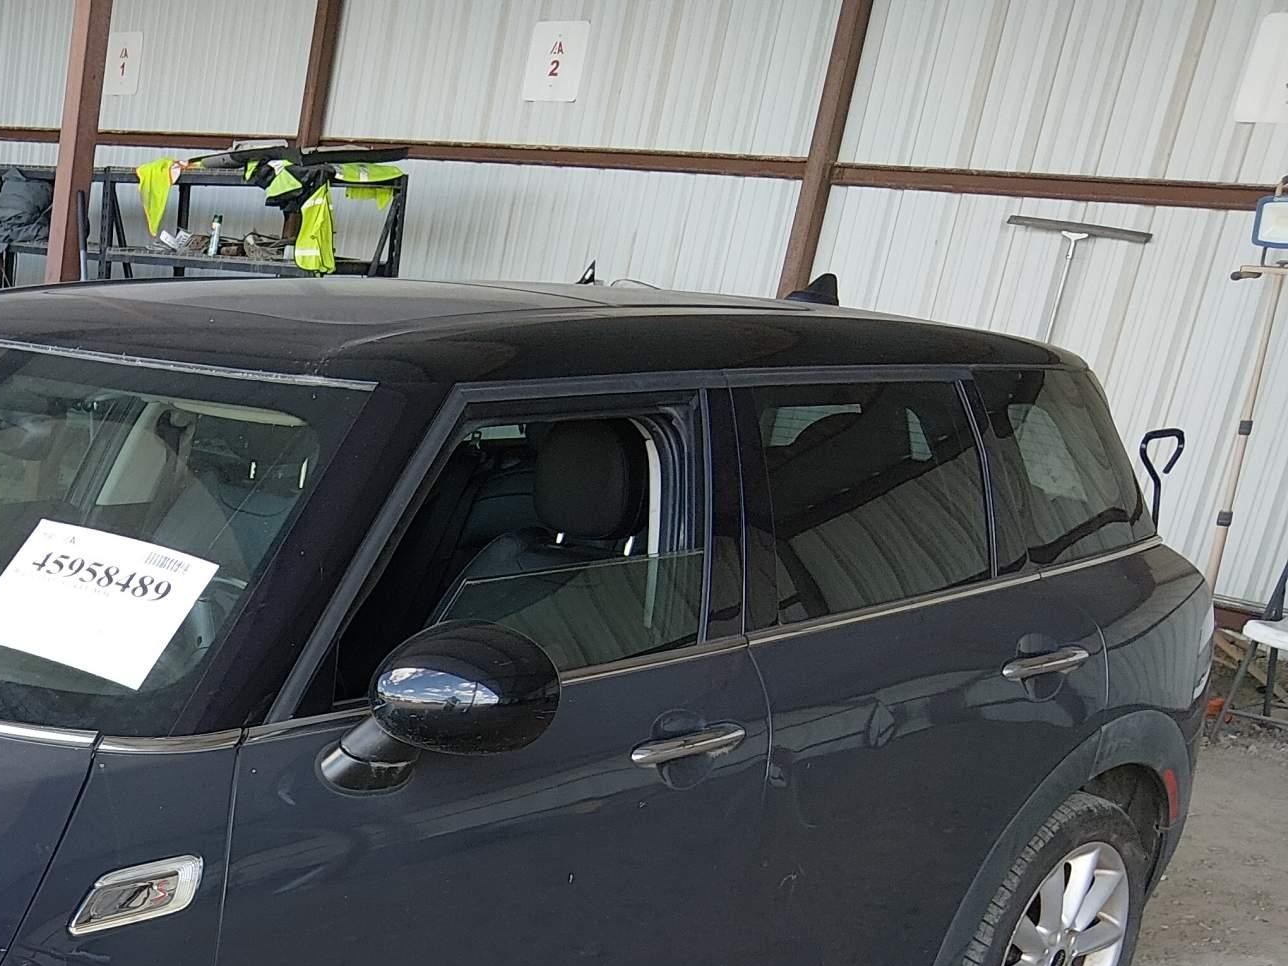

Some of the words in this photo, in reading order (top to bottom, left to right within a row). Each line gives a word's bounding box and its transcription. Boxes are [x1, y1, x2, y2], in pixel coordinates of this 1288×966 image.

[120, 61, 126, 77] 1
[548, 59, 560, 77] 2
[32, 551, 172, 601] 45958489
